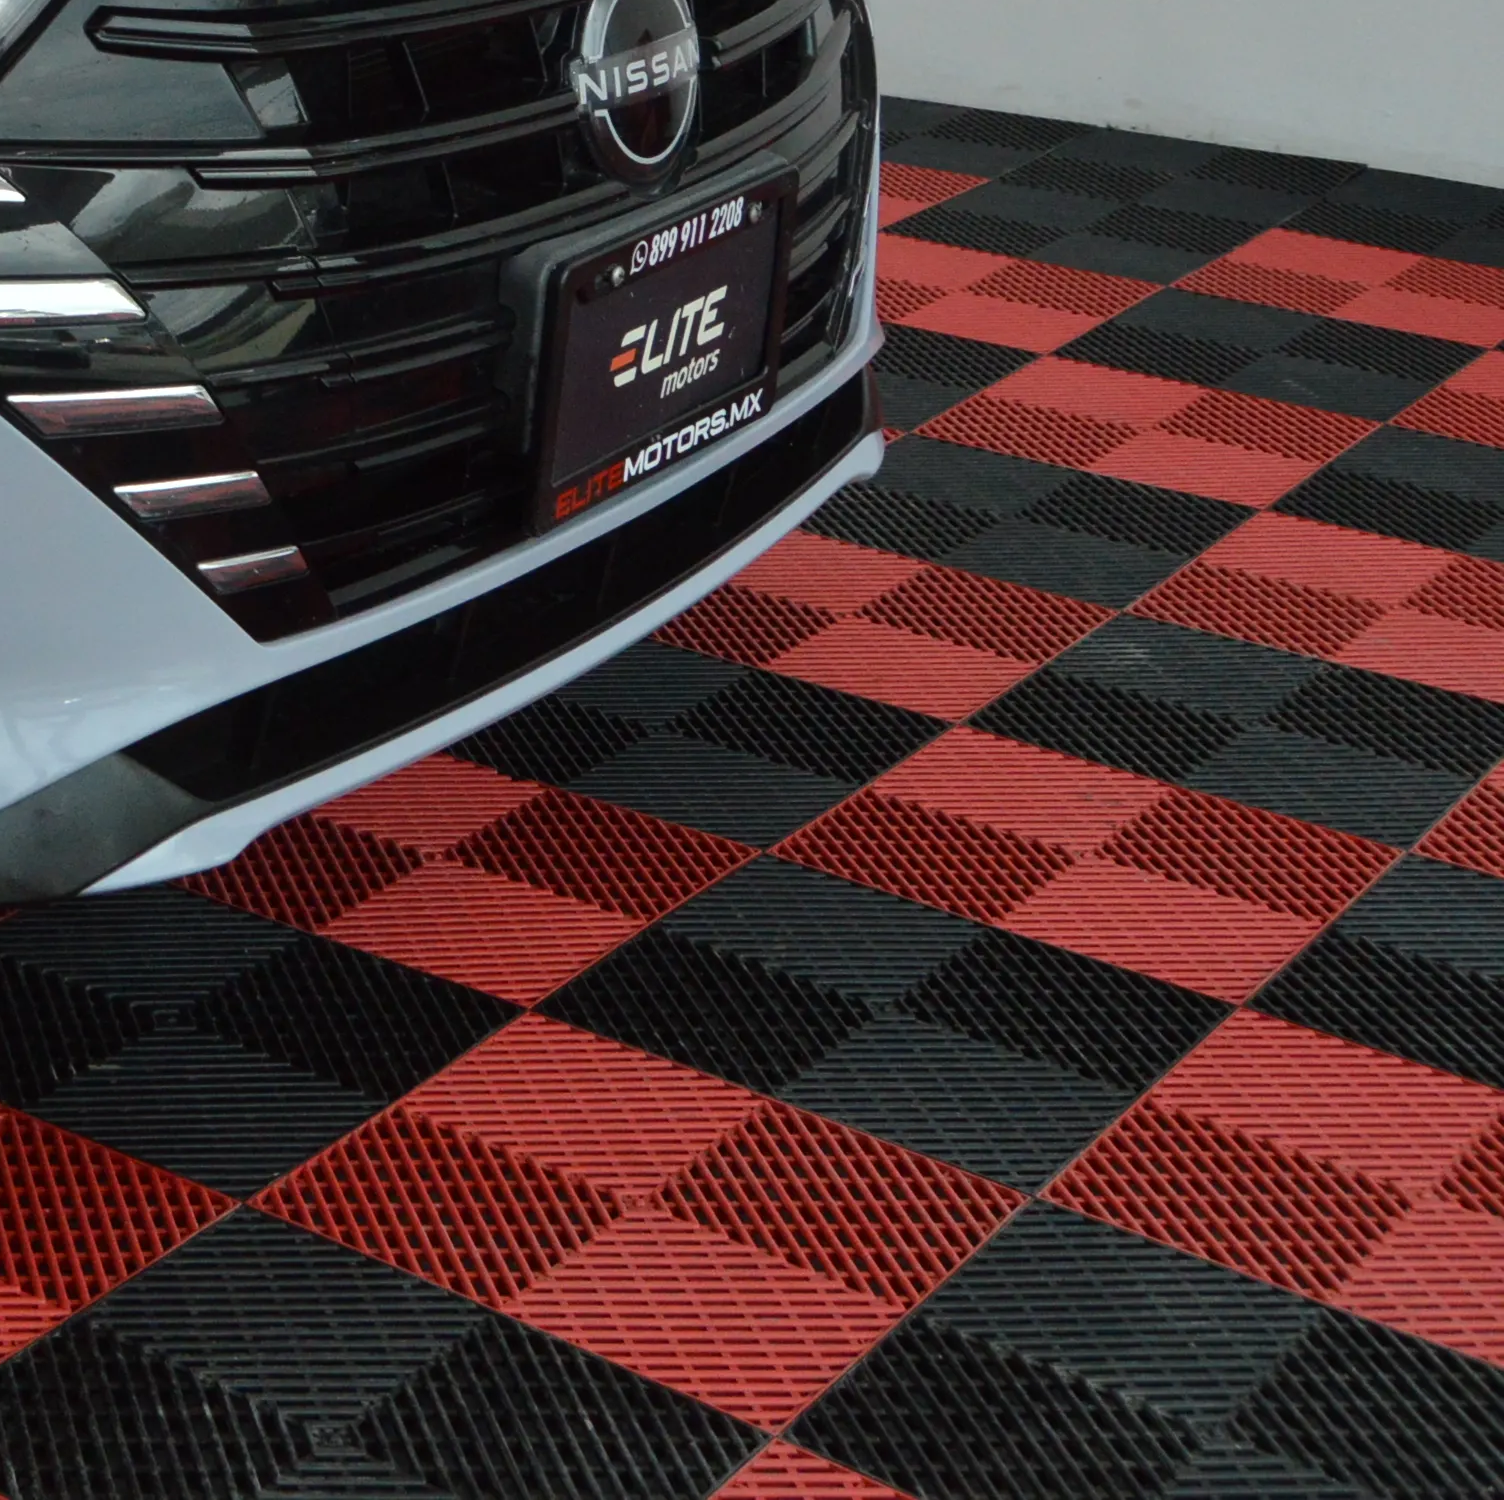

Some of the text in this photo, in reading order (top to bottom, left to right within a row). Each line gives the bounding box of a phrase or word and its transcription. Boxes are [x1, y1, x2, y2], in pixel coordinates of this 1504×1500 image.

[578, 33, 700, 105] NISSAN
[648, 196, 744, 266] 899 911 2208
[610, 285, 727, 388] ELITE
[660, 349, 721, 399] motors
[555, 388, 763, 520] ELITEMOTORS.MX
